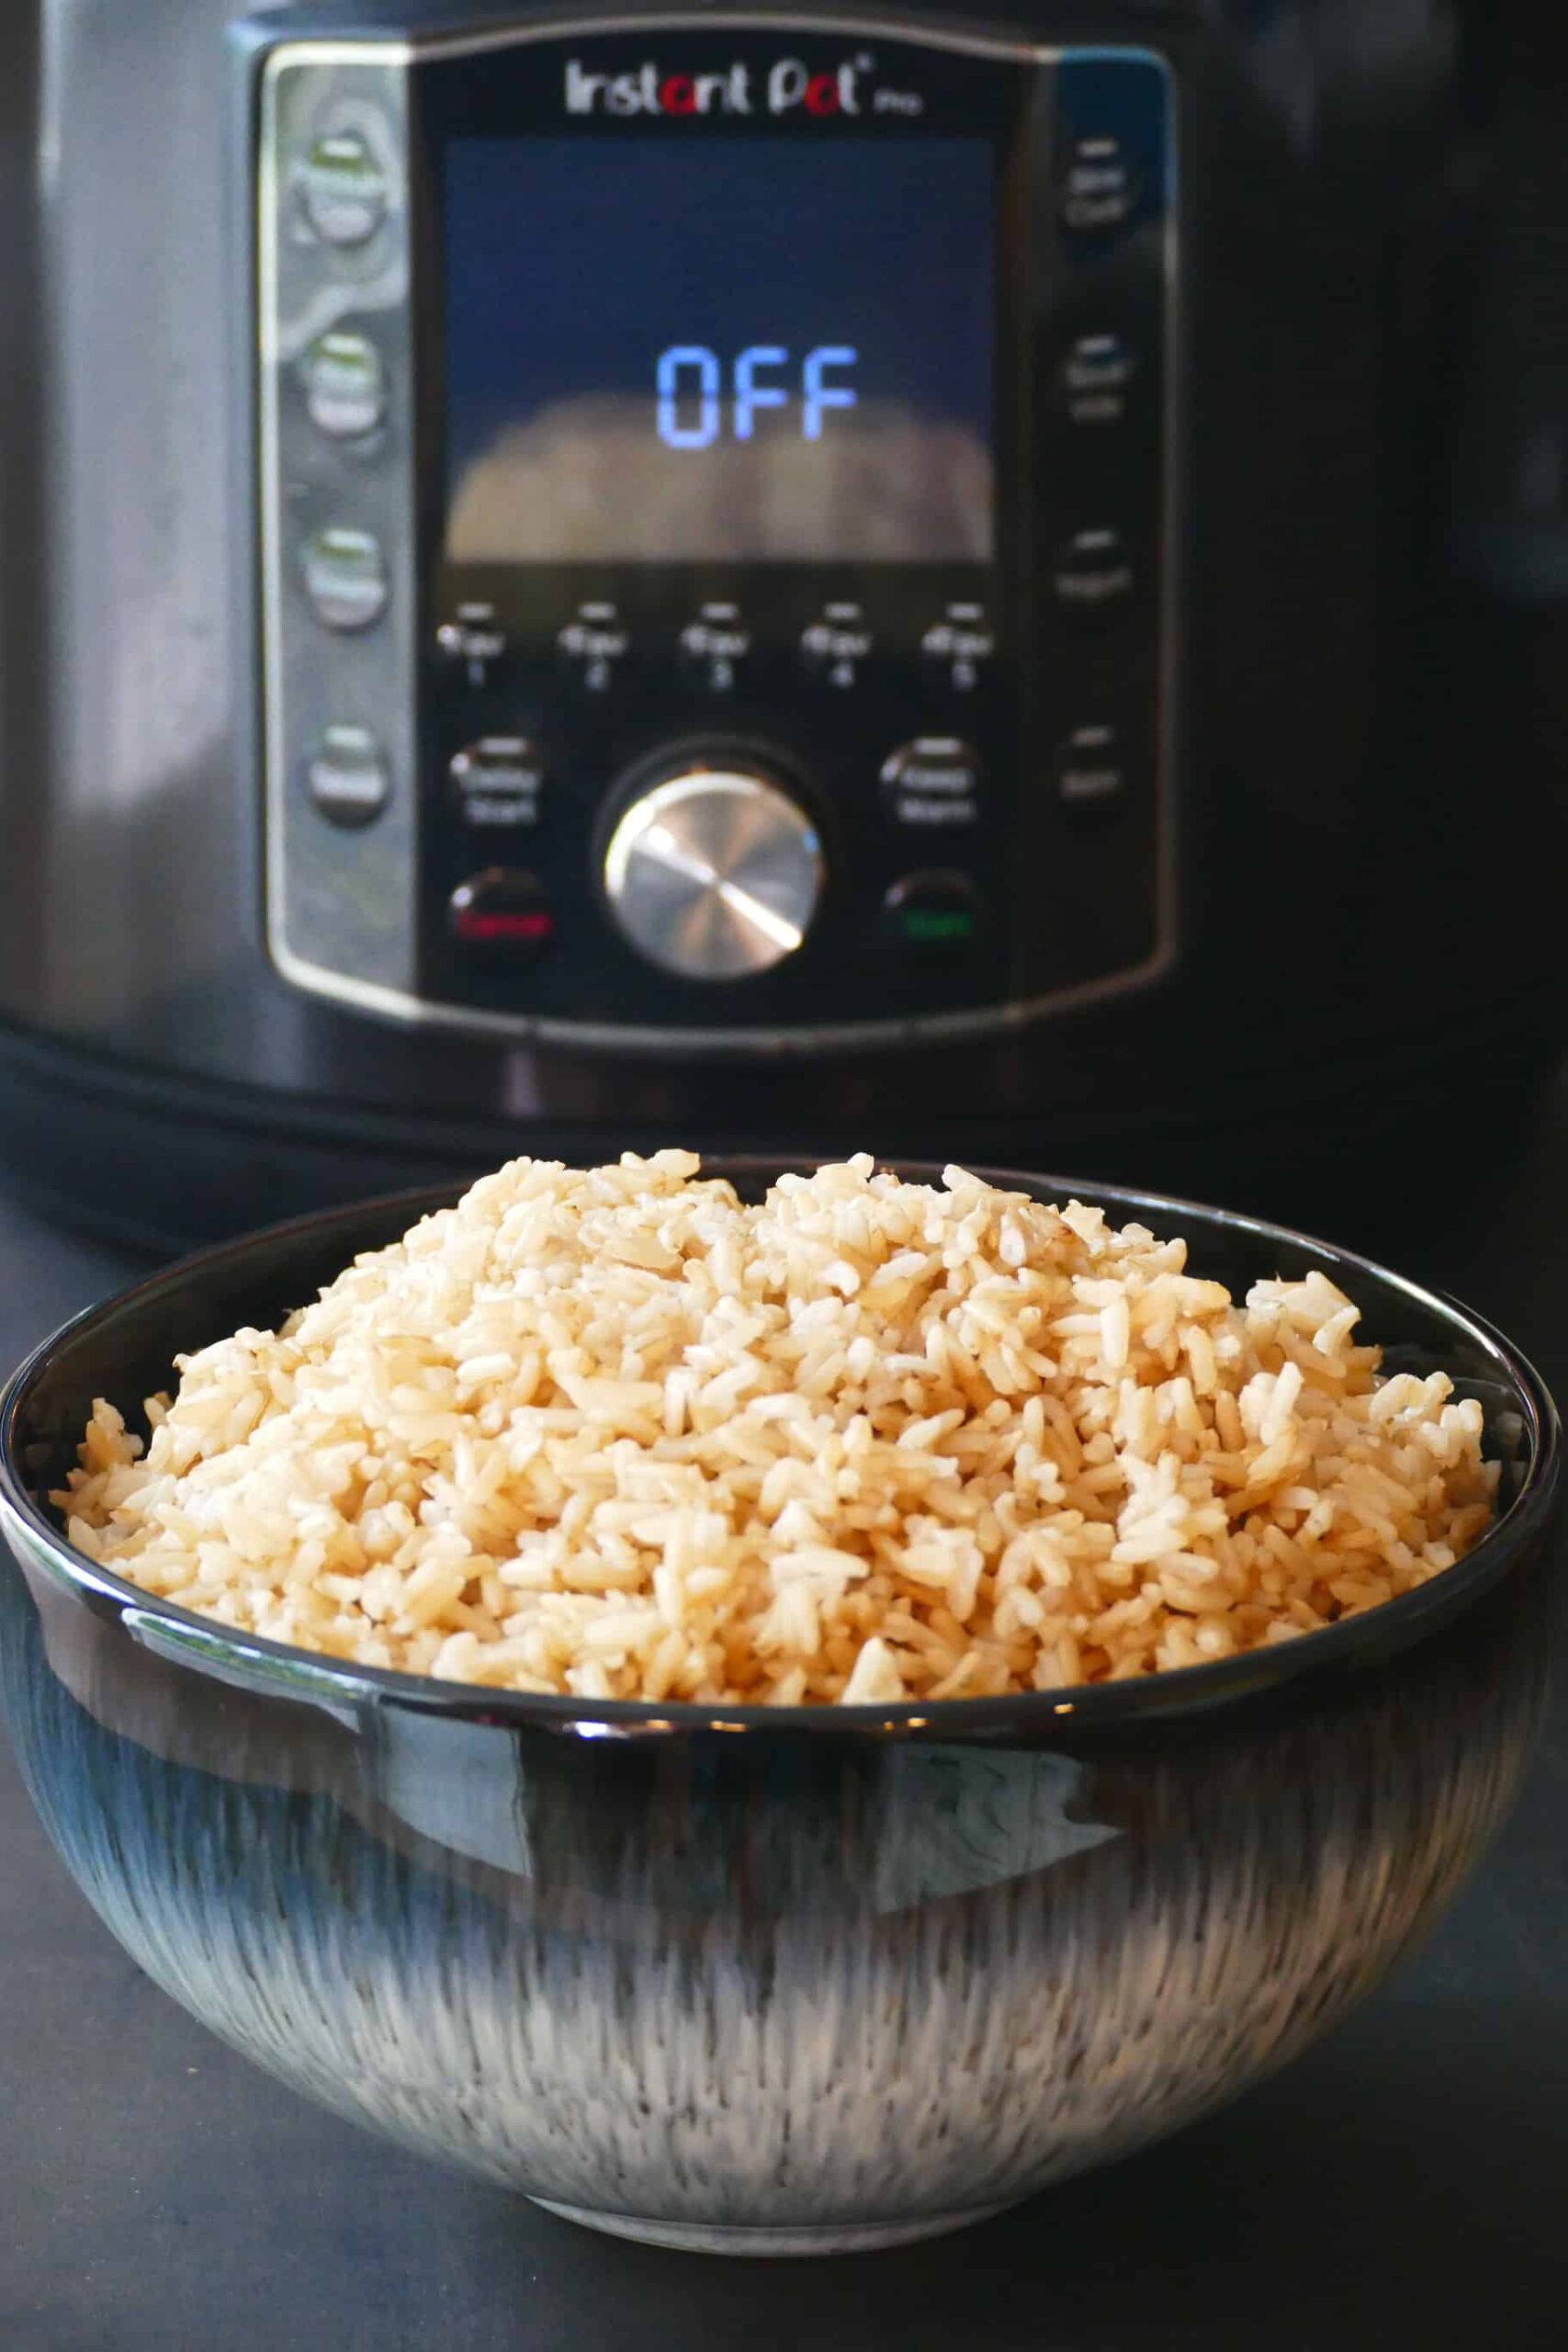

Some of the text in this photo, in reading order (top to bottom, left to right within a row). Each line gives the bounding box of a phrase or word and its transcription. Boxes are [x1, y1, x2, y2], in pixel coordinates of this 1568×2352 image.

[564, 57, 752, 116] Instant
[767, 56, 861, 116] Pot
[657, 345, 858, 450] OFF
